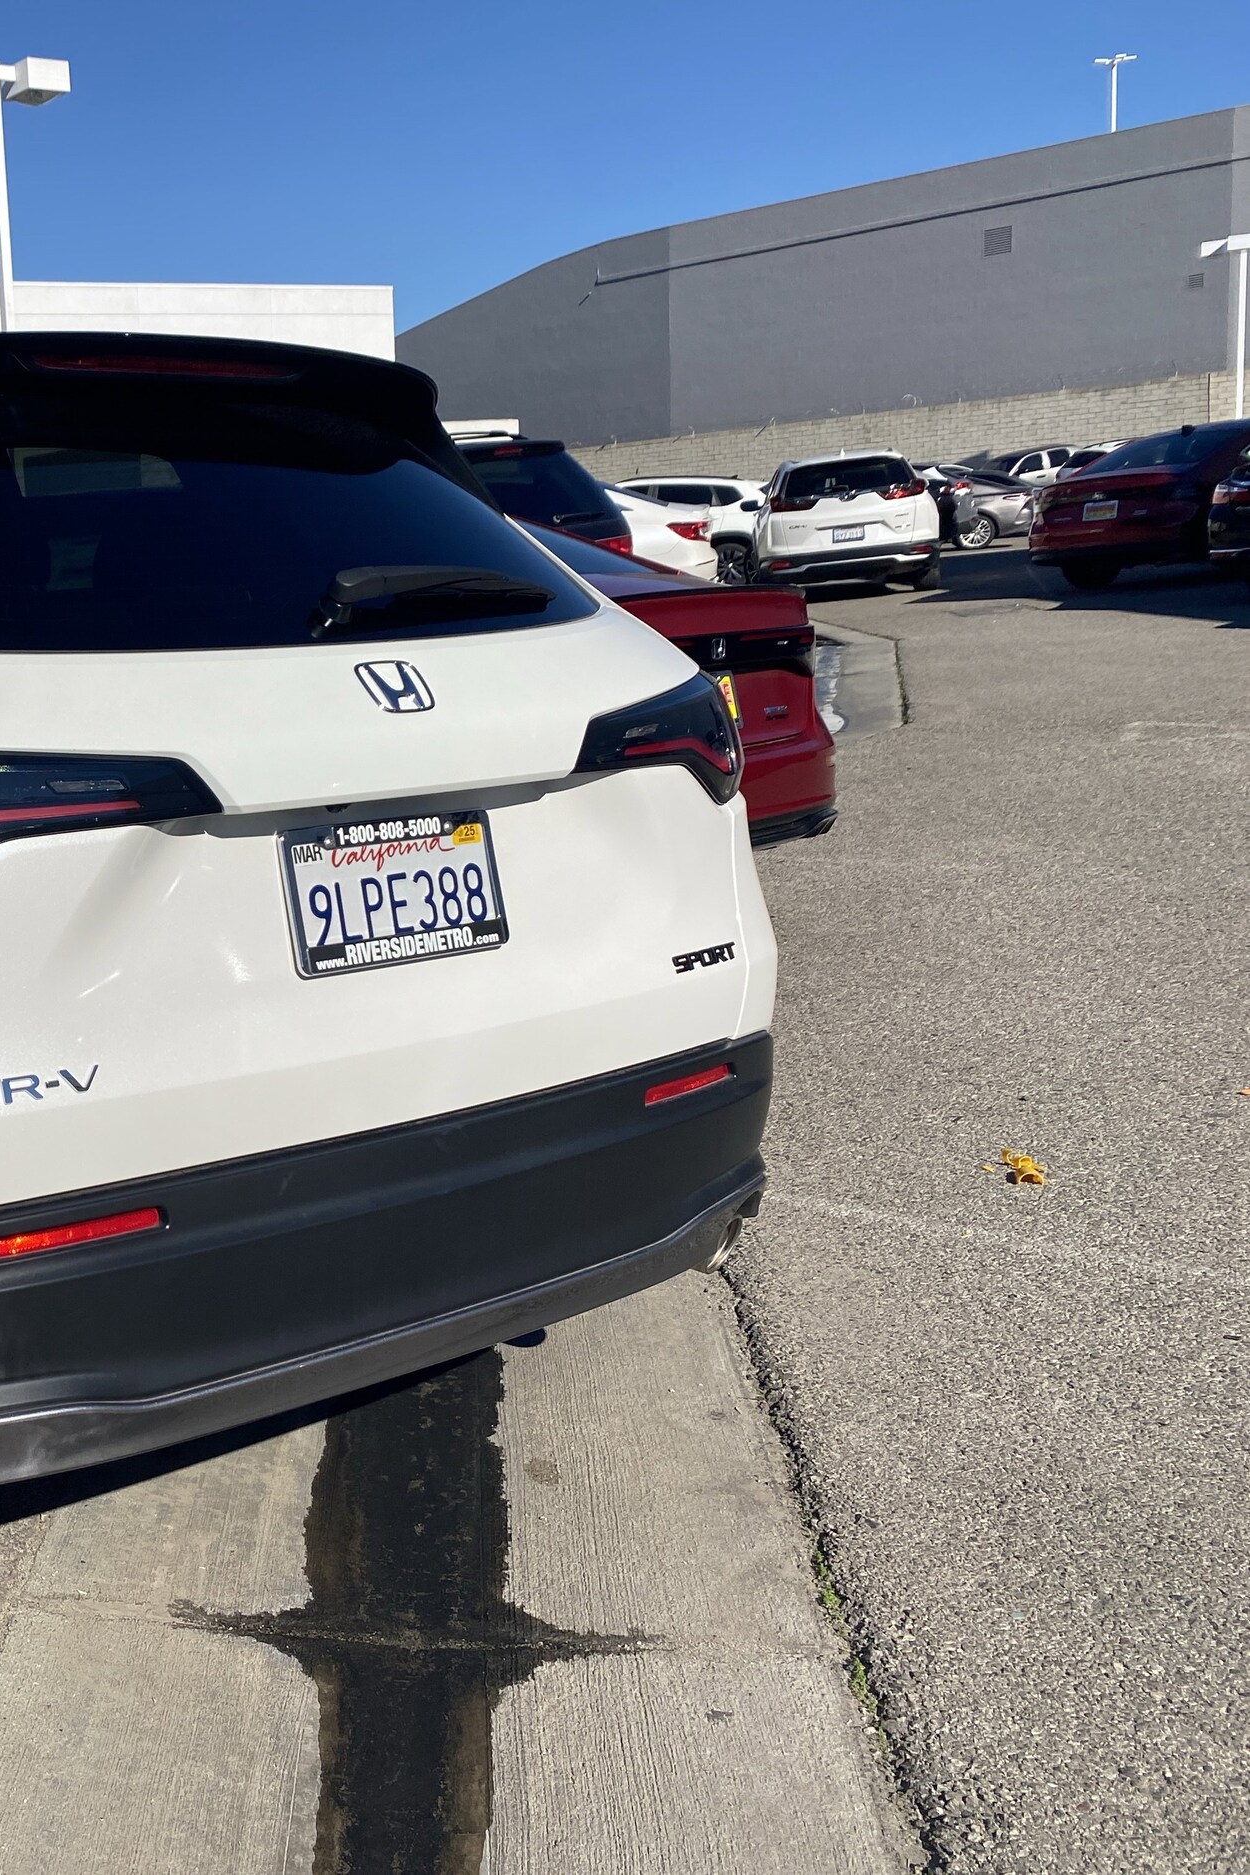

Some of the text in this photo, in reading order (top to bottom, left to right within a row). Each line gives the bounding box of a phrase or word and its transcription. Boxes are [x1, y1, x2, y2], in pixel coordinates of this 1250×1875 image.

[337, 817, 441, 846] 1-800-808-5000
[464, 825, 476, 837] 25
[293, 845, 323, 864] MAR
[308, 862, 488, 946] 9LPE388
[316, 926, 499, 971] www.RIVERSIDEMETRO.com
[671, 941, 736, 974] SPORT
